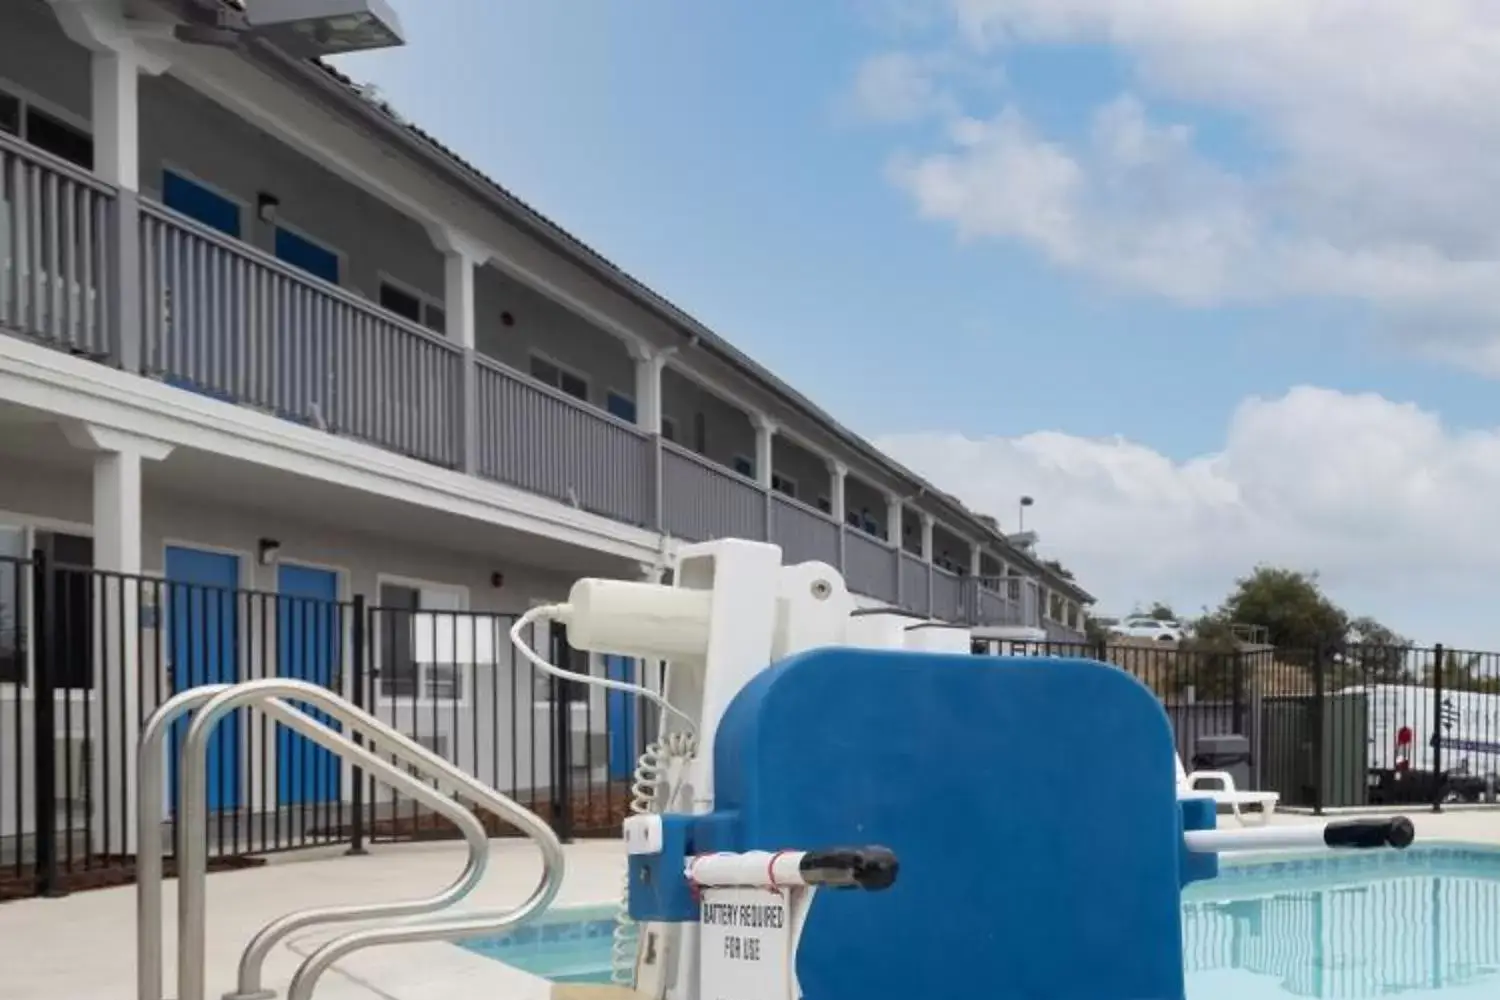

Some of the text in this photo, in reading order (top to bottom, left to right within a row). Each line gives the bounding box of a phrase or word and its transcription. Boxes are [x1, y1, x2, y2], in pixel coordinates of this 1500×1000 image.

[703, 903, 783, 929] BATTERY REQUIRED
[724, 936, 760, 961] FOR USE
